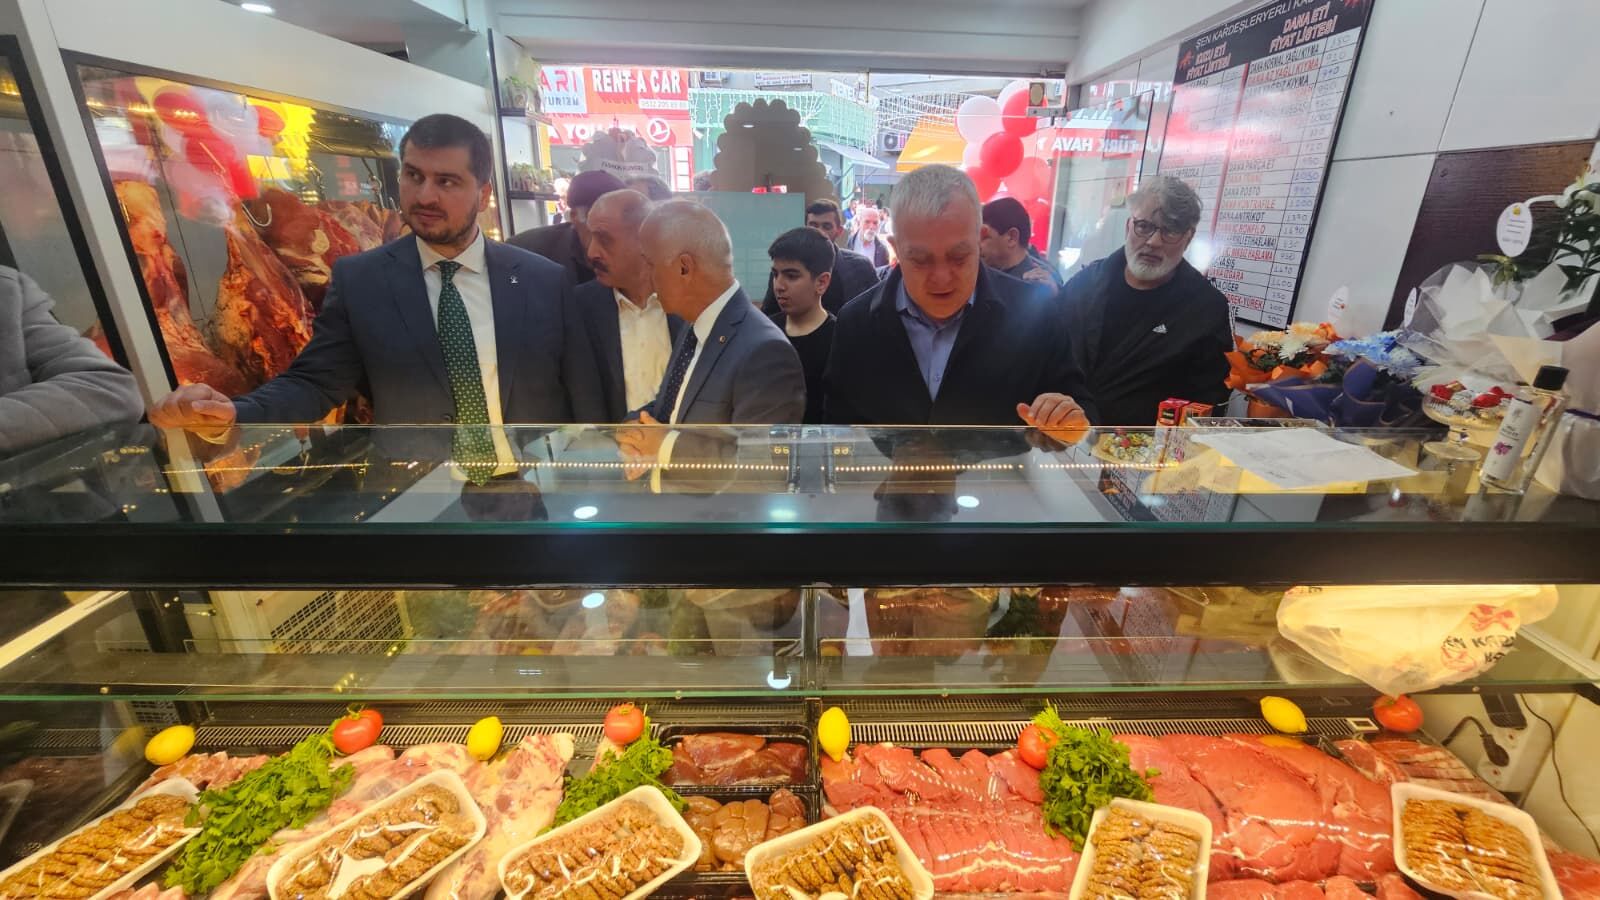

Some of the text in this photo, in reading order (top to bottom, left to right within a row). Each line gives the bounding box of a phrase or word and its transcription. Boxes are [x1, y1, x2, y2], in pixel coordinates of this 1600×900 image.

[1282, 11, 1311, 34] DANA
[1269, 32, 1298, 54] FİYAT
[650, 70, 682, 94] CAR
